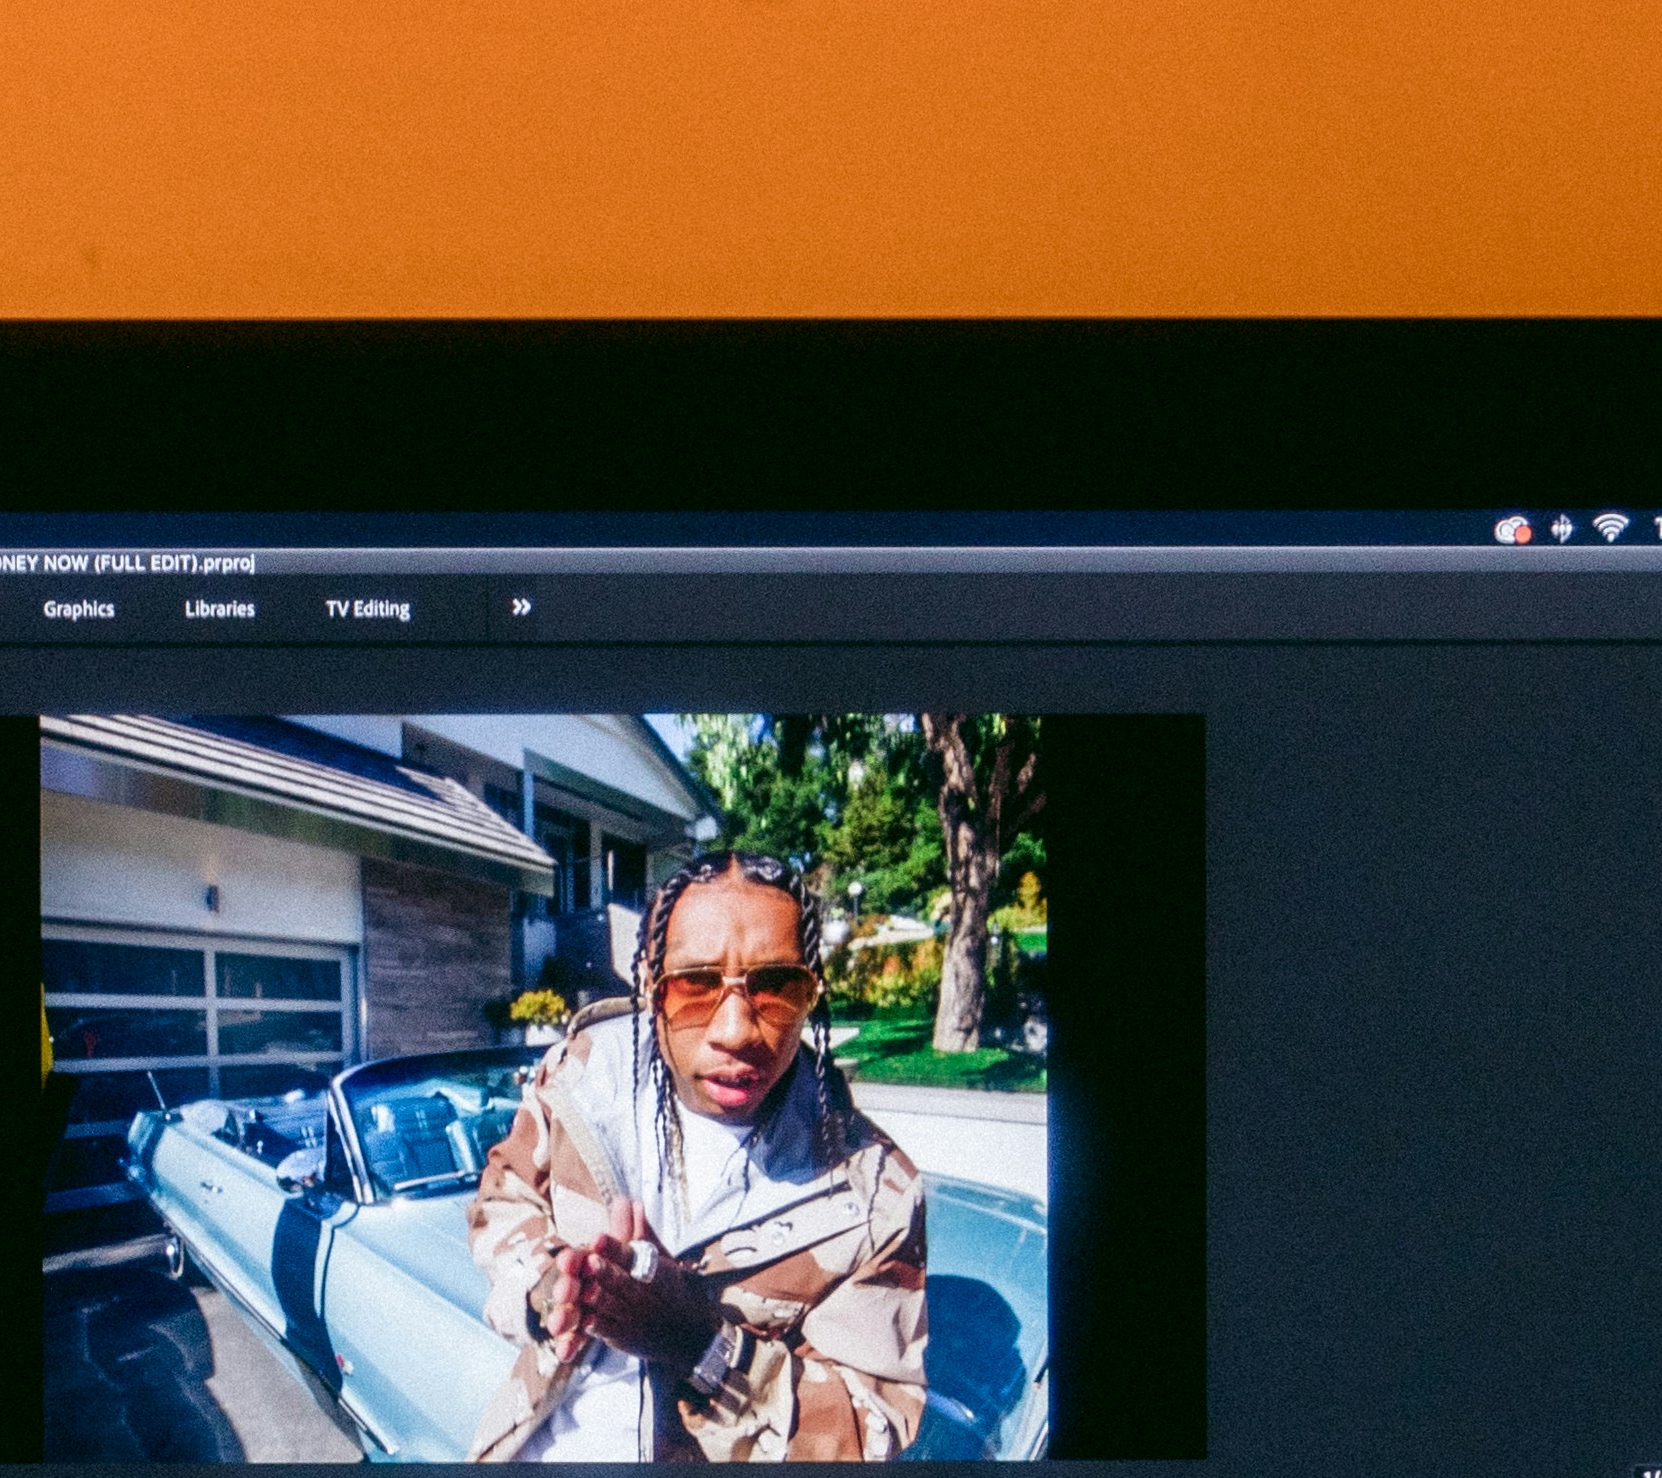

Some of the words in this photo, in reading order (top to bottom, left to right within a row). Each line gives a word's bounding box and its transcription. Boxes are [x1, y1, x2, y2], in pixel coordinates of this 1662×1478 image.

[43, 554, 89, 572] NOW
[94, 554, 146, 573] (FULL
[150, 553, 256, 574] EDIT).prproj
[43, 599, 115, 621] Graphics
[185, 599, 256, 618] Libraries
[325, 599, 350, 617] TV
[353, 599, 411, 622] Editing
